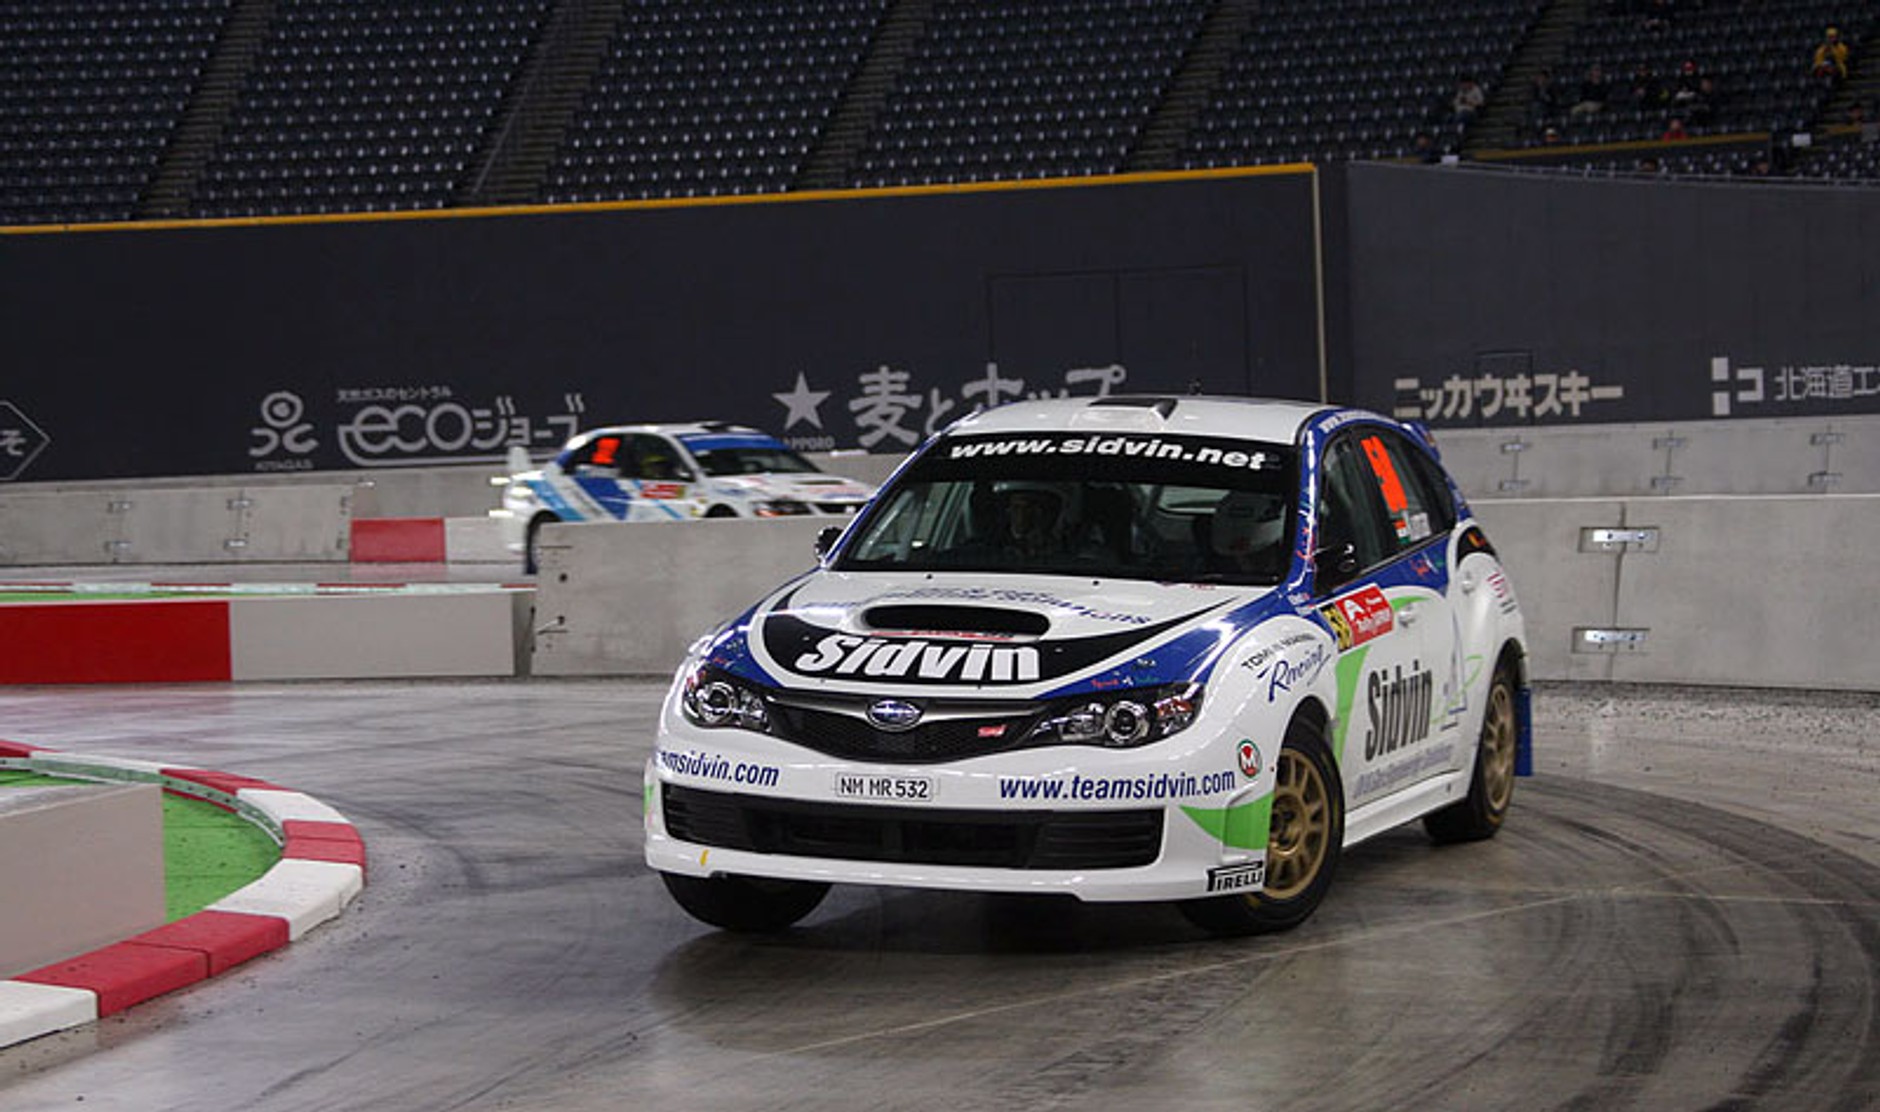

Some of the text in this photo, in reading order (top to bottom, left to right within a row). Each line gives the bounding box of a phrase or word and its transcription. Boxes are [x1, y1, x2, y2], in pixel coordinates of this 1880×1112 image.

[1393, 371, 1623, 419] ニッカウヰスキー
[1774, 365, 1880, 400] 北海道エ
[951, 436, 1266, 470] www.sidvin.net
[794, 634, 1040, 682] Sidvin
[1364, 658, 1433, 762] Sidvin
[841, 778, 864, 796] NM
[895, 780, 928, 798] 532
[1000, 770, 1236, 800] www.teamsidvin.com
